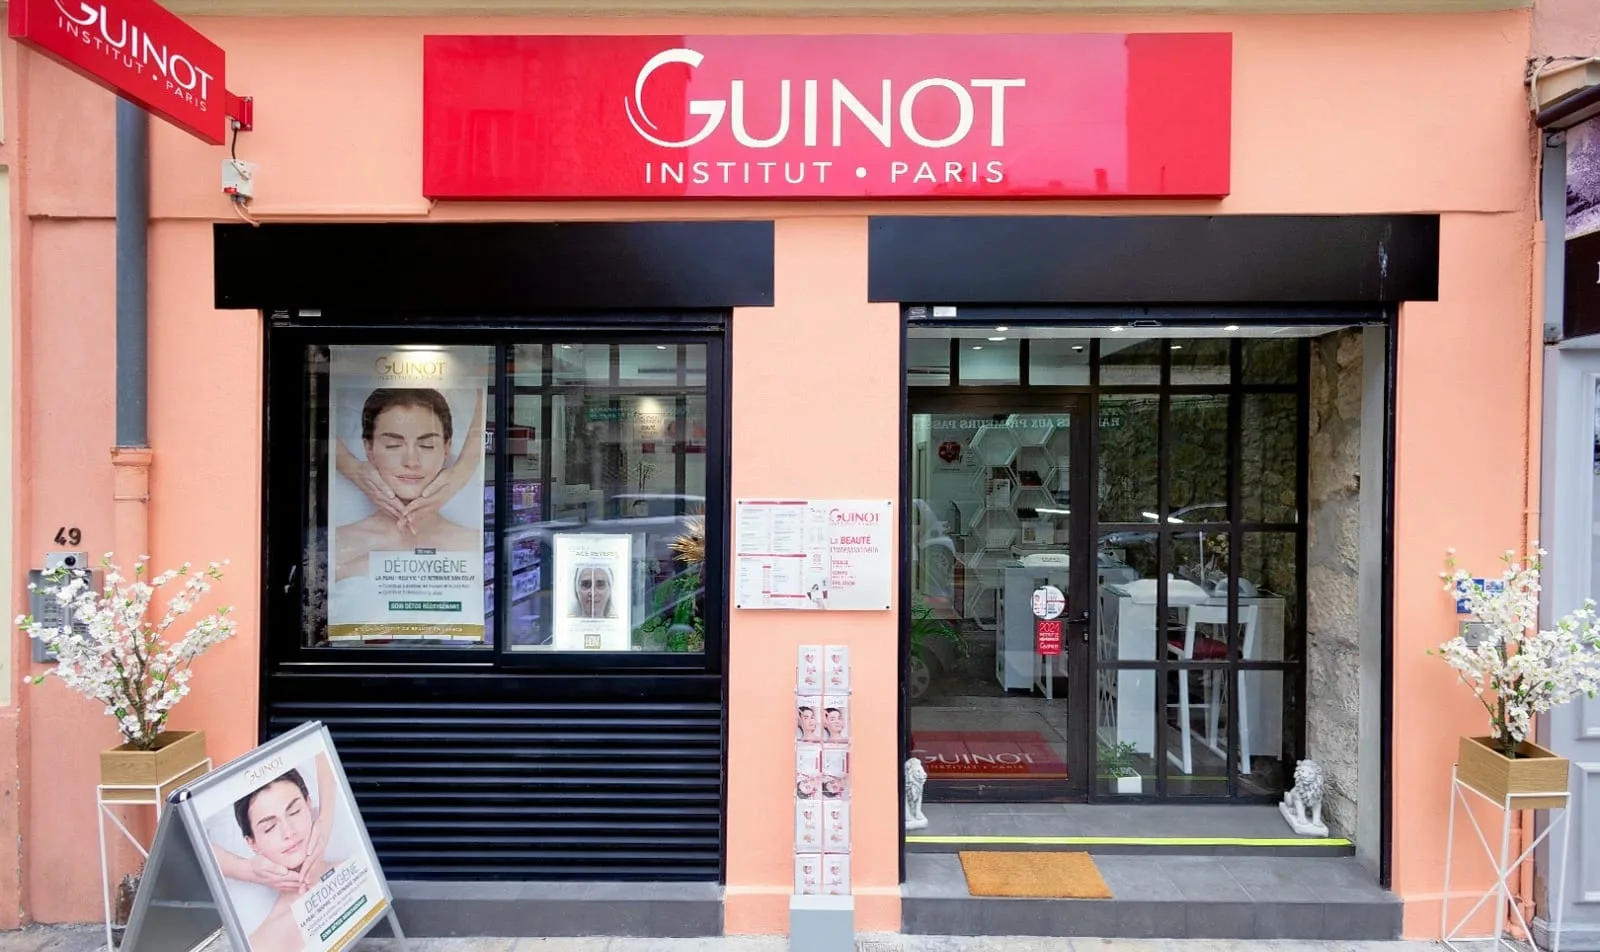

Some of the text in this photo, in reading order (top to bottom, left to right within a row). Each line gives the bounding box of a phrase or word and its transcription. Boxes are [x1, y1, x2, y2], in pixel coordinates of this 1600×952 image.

[58, 16, 208, 112] INSTITUT PARIS
[624, 48, 1026, 148] GUINOT
[646, 161, 1004, 184] INSTITUT PARIS
[374, 356, 446, 375] GUINOT
[829, 508, 881, 522] GUINOT
[54, 527, 82, 546] 49
[840, 535, 871, 544] BEAUTÉ
[384, 557, 468, 573] DÉTOXYGÈNE
